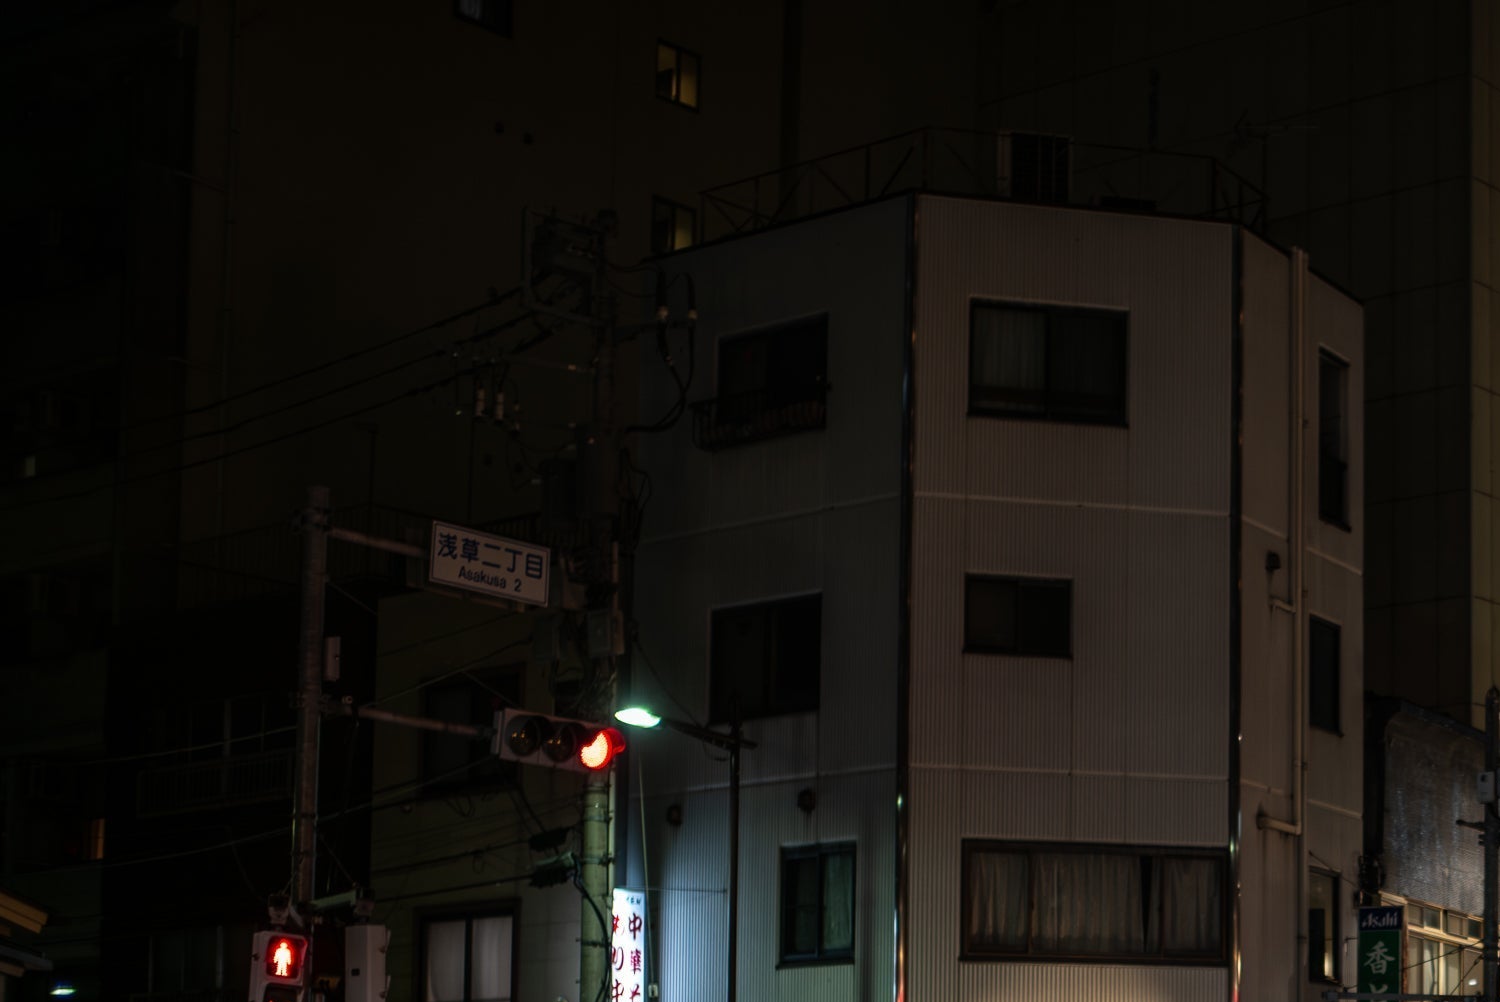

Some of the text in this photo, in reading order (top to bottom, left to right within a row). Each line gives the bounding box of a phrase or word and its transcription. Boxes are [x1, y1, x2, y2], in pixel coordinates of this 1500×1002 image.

[437, 532, 544, 579] 浅草二丁目
[457, 566, 522, 593] Asakusa 2
[1362, 911, 1398, 929] Asahi
